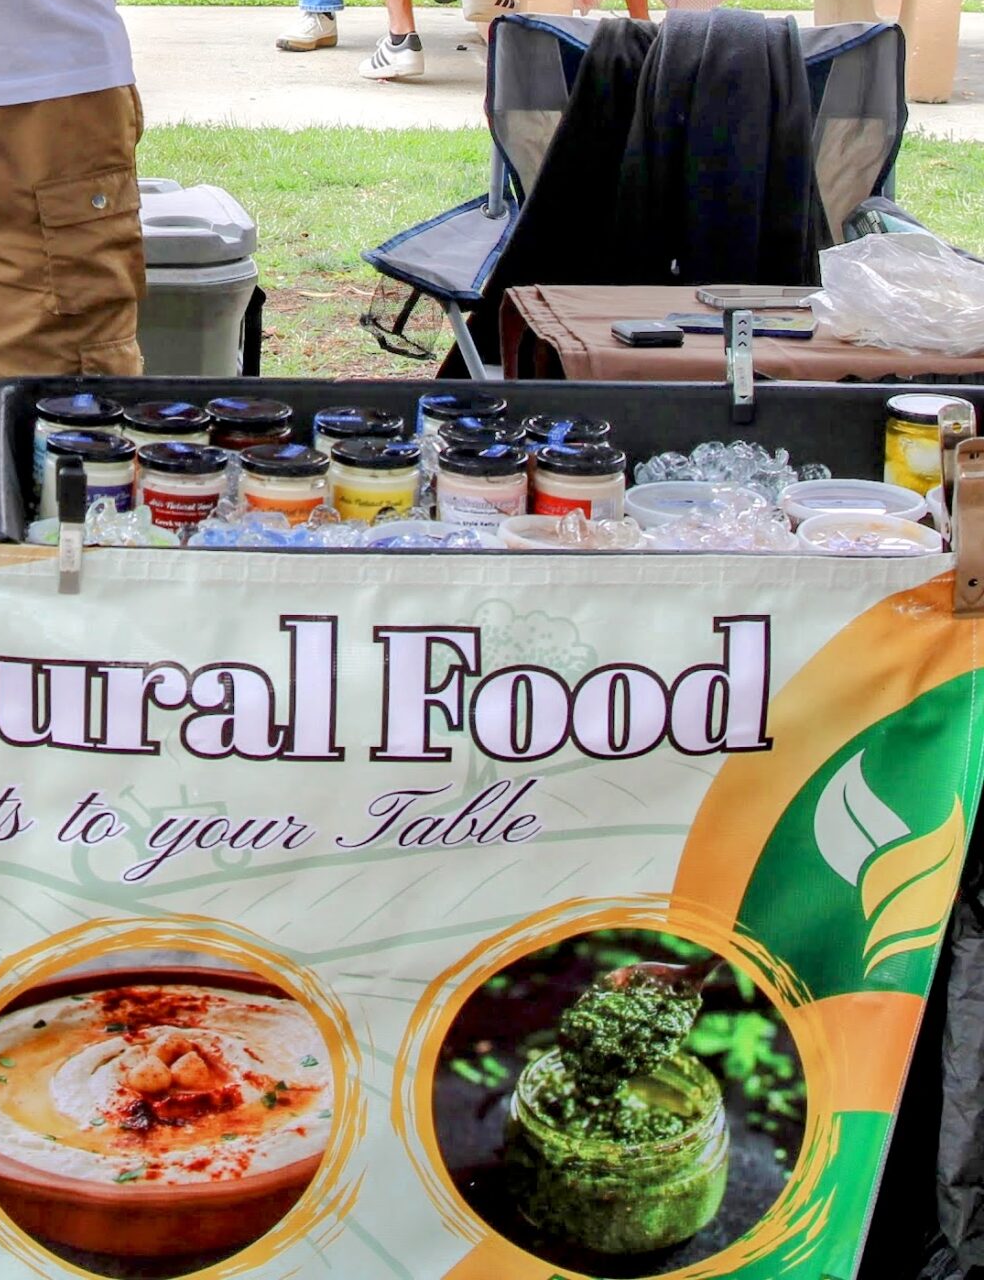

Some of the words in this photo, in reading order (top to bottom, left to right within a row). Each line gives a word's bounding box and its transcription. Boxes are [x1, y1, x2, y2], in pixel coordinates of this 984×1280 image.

[369, 613, 773, 762] Food
[57, 790, 123, 846] to
[123, 808, 317, 883] your
[336, 777, 542, 850] Table
